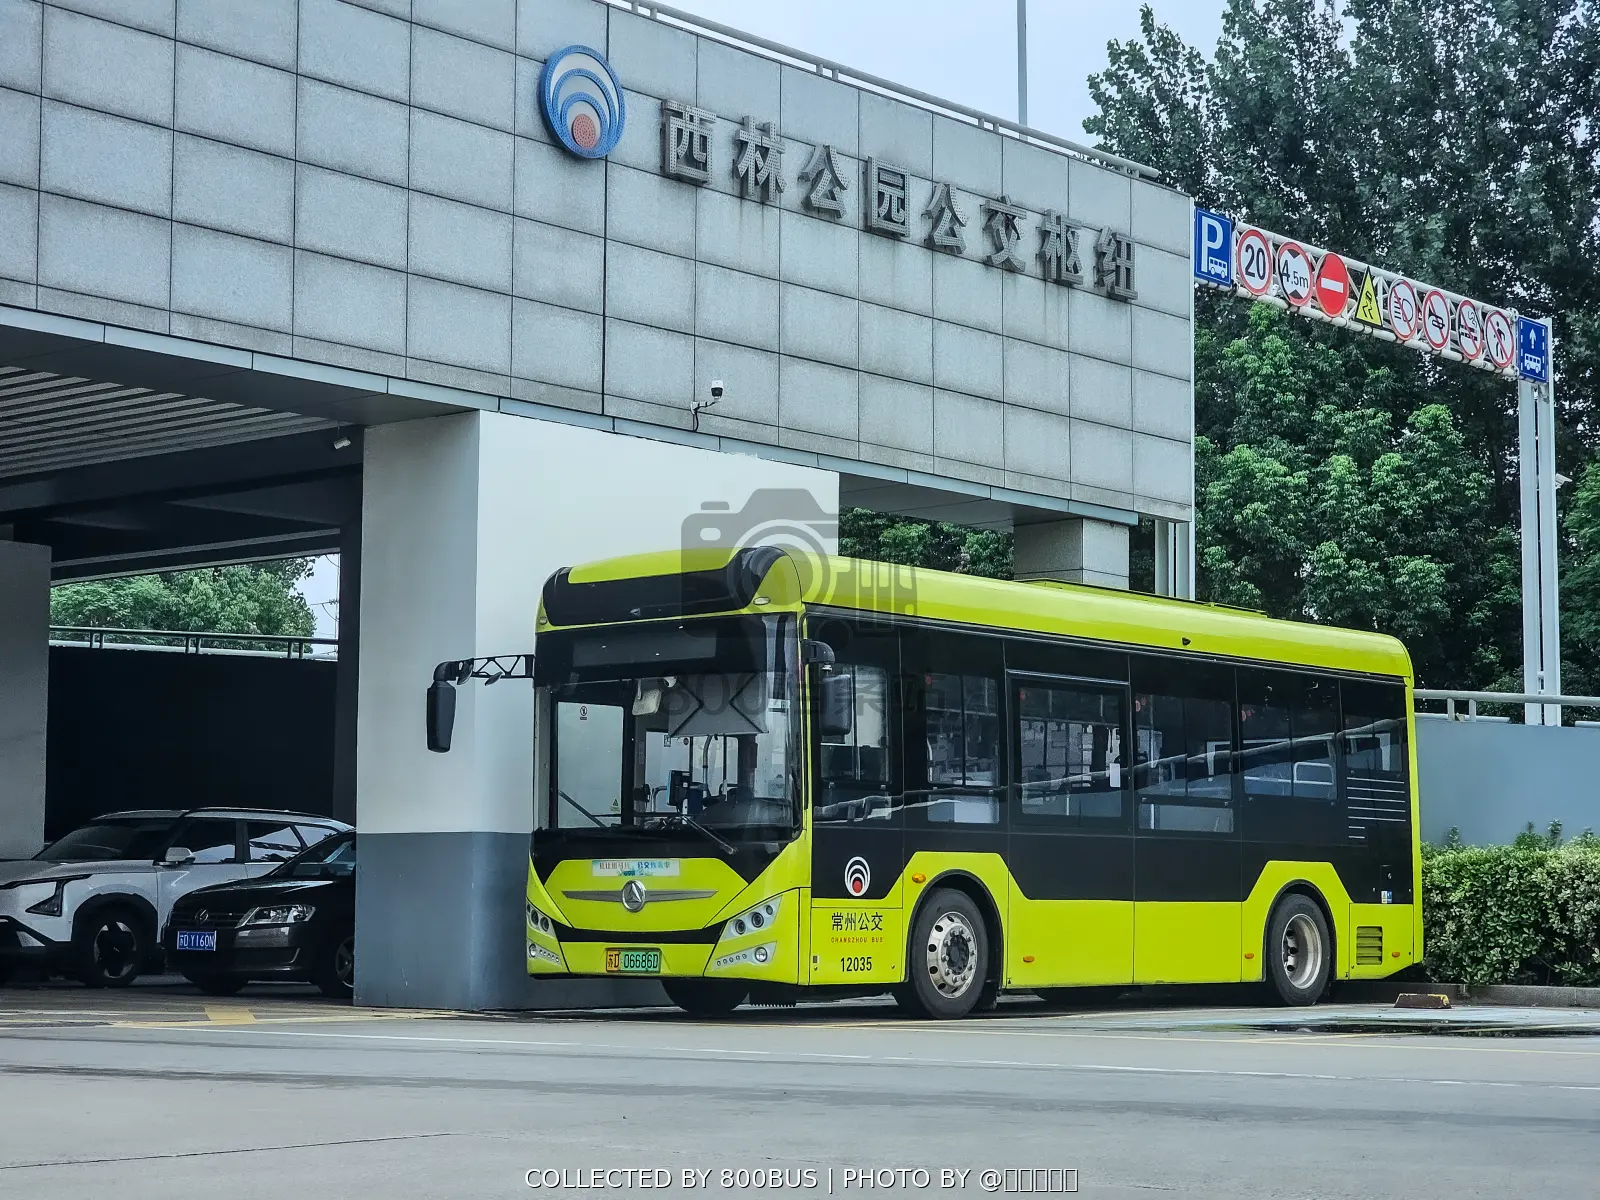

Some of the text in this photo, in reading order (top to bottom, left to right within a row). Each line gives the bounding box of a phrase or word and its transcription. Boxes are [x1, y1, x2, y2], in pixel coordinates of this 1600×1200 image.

[662, 99, 1138, 300] 西林公园公交枢纽
[1200, 215, 1224, 273] P
[1244, 243, 1266, 280] 20
[1281, 259, 1309, 289] 4.5m
[831, 911, 883, 931] 常州公交
[840, 956, 872, 972] 12035
